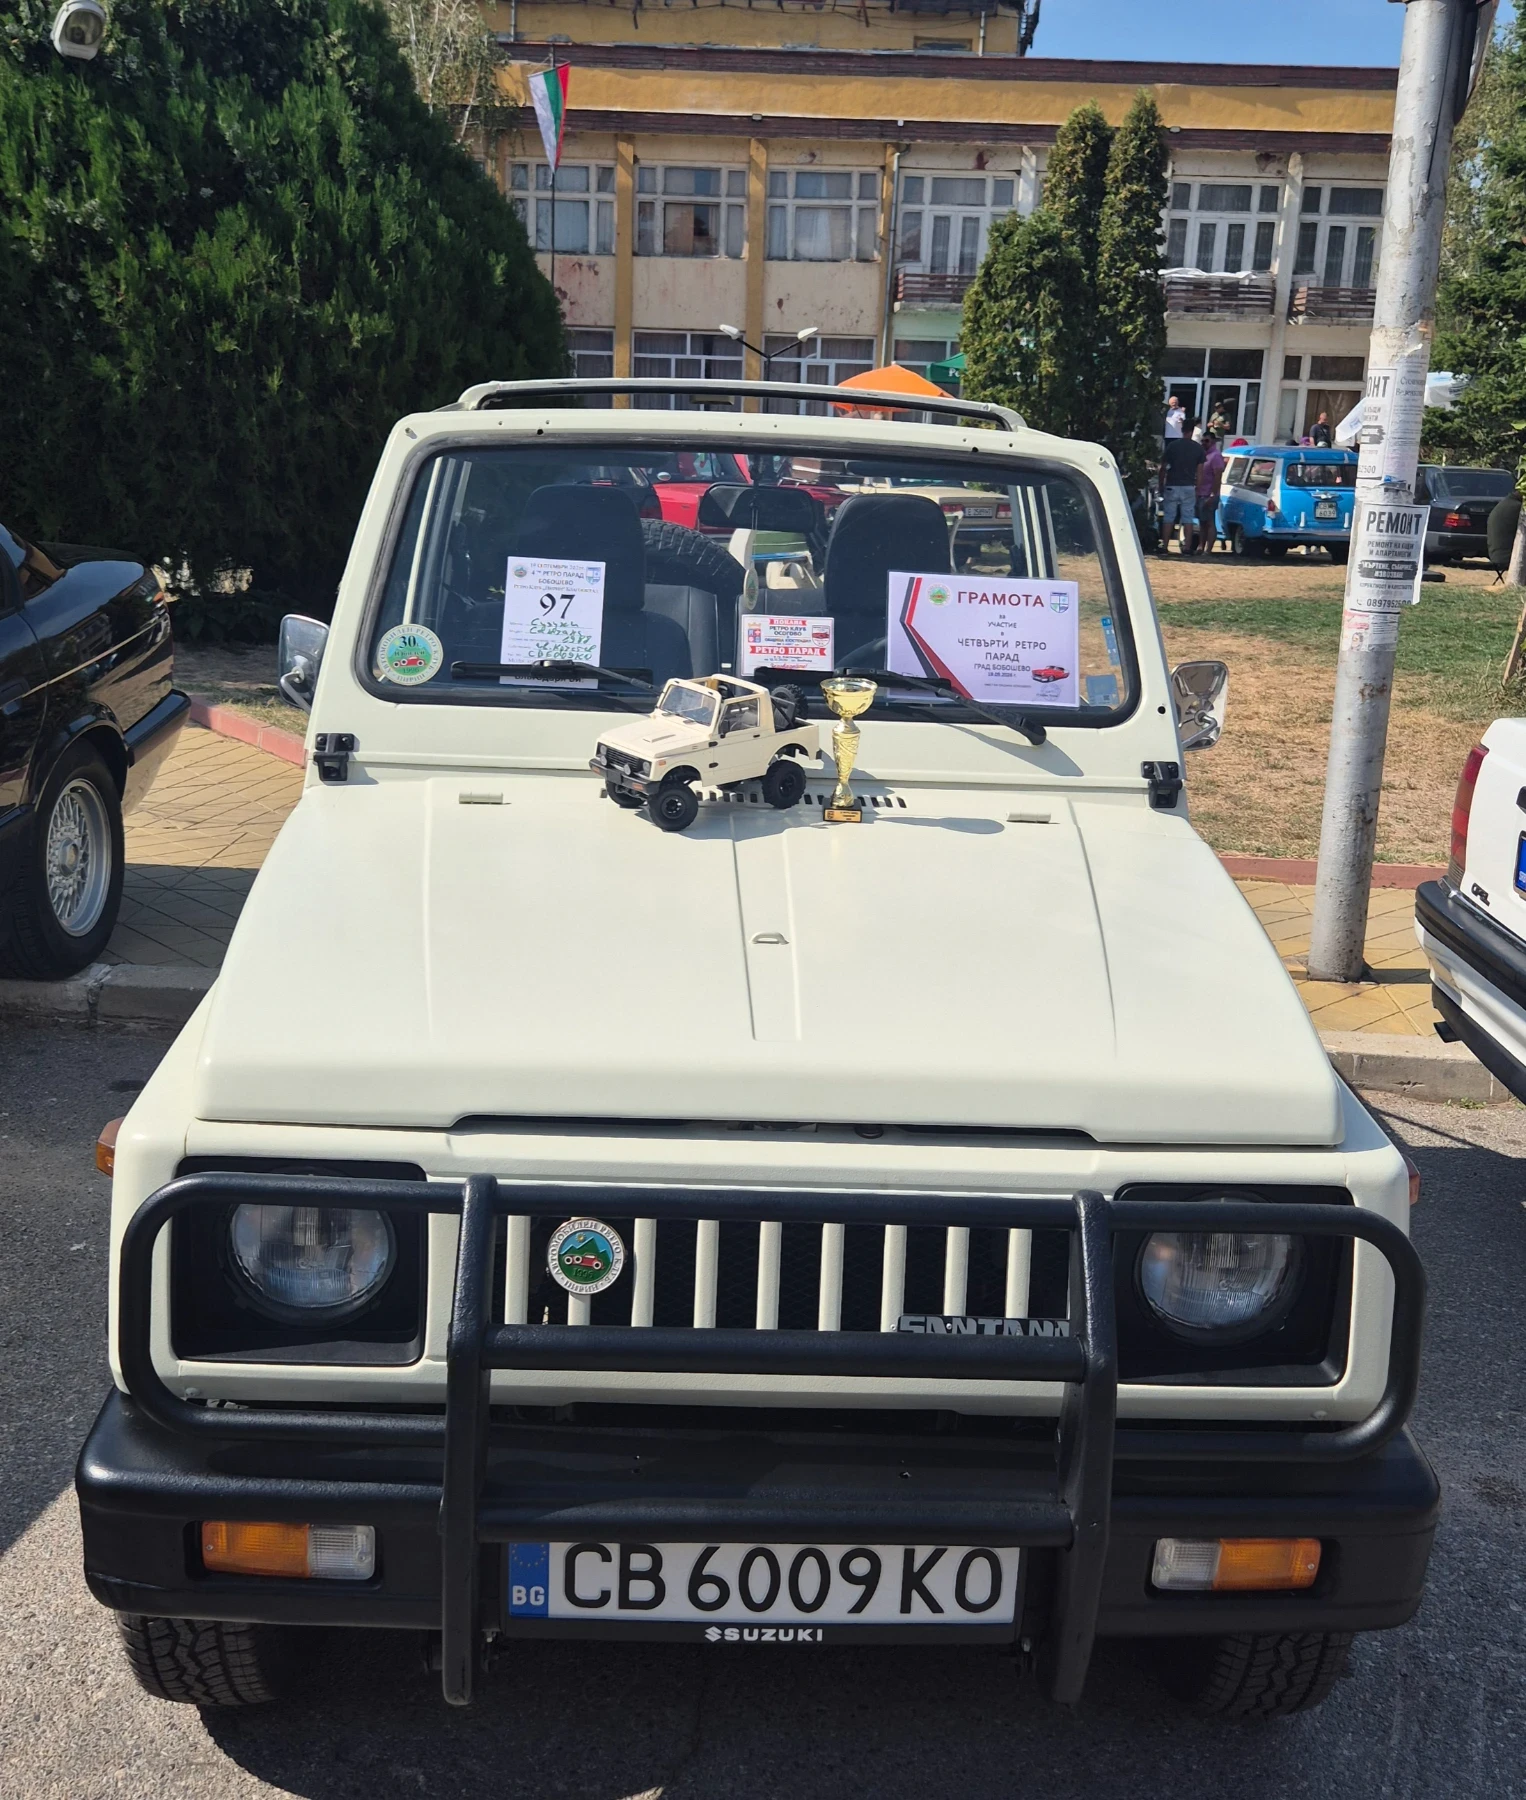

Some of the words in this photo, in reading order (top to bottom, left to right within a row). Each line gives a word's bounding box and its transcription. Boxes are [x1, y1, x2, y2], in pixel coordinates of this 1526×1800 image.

[1366, 511, 1422, 535] РЕМОНТ
[539, 593, 576, 619] 97
[957, 591, 1044, 607] ГРАМОТА
[399, 635, 417, 648] 30
[957, 638, 1009, 648] ЧЕТВЪРТИ
[1015, 640, 1047, 650] РЕТРО
[755, 646, 786, 654] РЕТРО
[788, 647, 821, 656] ПАРАД
[985, 652, 1020, 663] ПАРАД
[992, 664, 1031, 672] БОБОШЕВО
[550, 1221, 597, 1275] АВТОМОБИЛЕН
[599, 1225, 622, 1254] РЕТРО
[564, 1280, 599, 1293] ПИРИН
[687, 1546, 882, 1614] 6009
[512, 1585, 545, 1606] BG
[723, 1627, 823, 1642] SUZUKI
